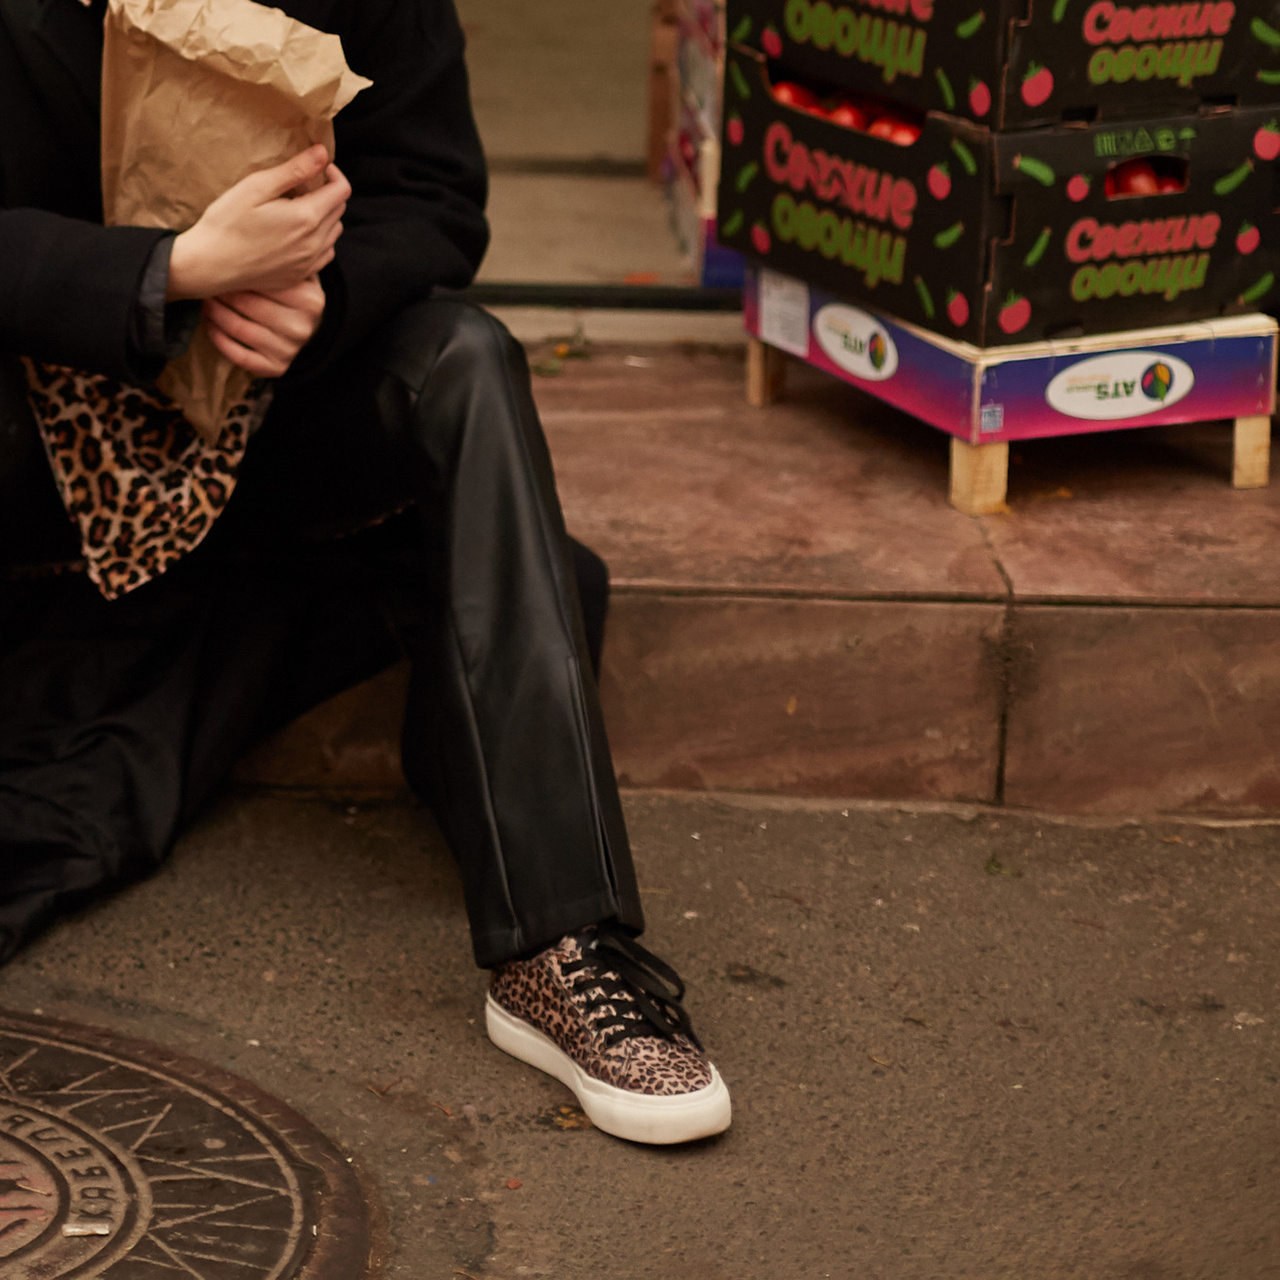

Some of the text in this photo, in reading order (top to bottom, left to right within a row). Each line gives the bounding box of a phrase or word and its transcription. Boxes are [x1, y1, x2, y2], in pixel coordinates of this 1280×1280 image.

[1083, 0, 1236, 45] Свежие
[1088, 37, 1224, 88] овощи
[771, 191, 907, 288] овощи
[1065, 211, 1222, 263] Свежие
[1070, 251, 1211, 302] овощи
[1096, 380, 1136, 400] ATS
